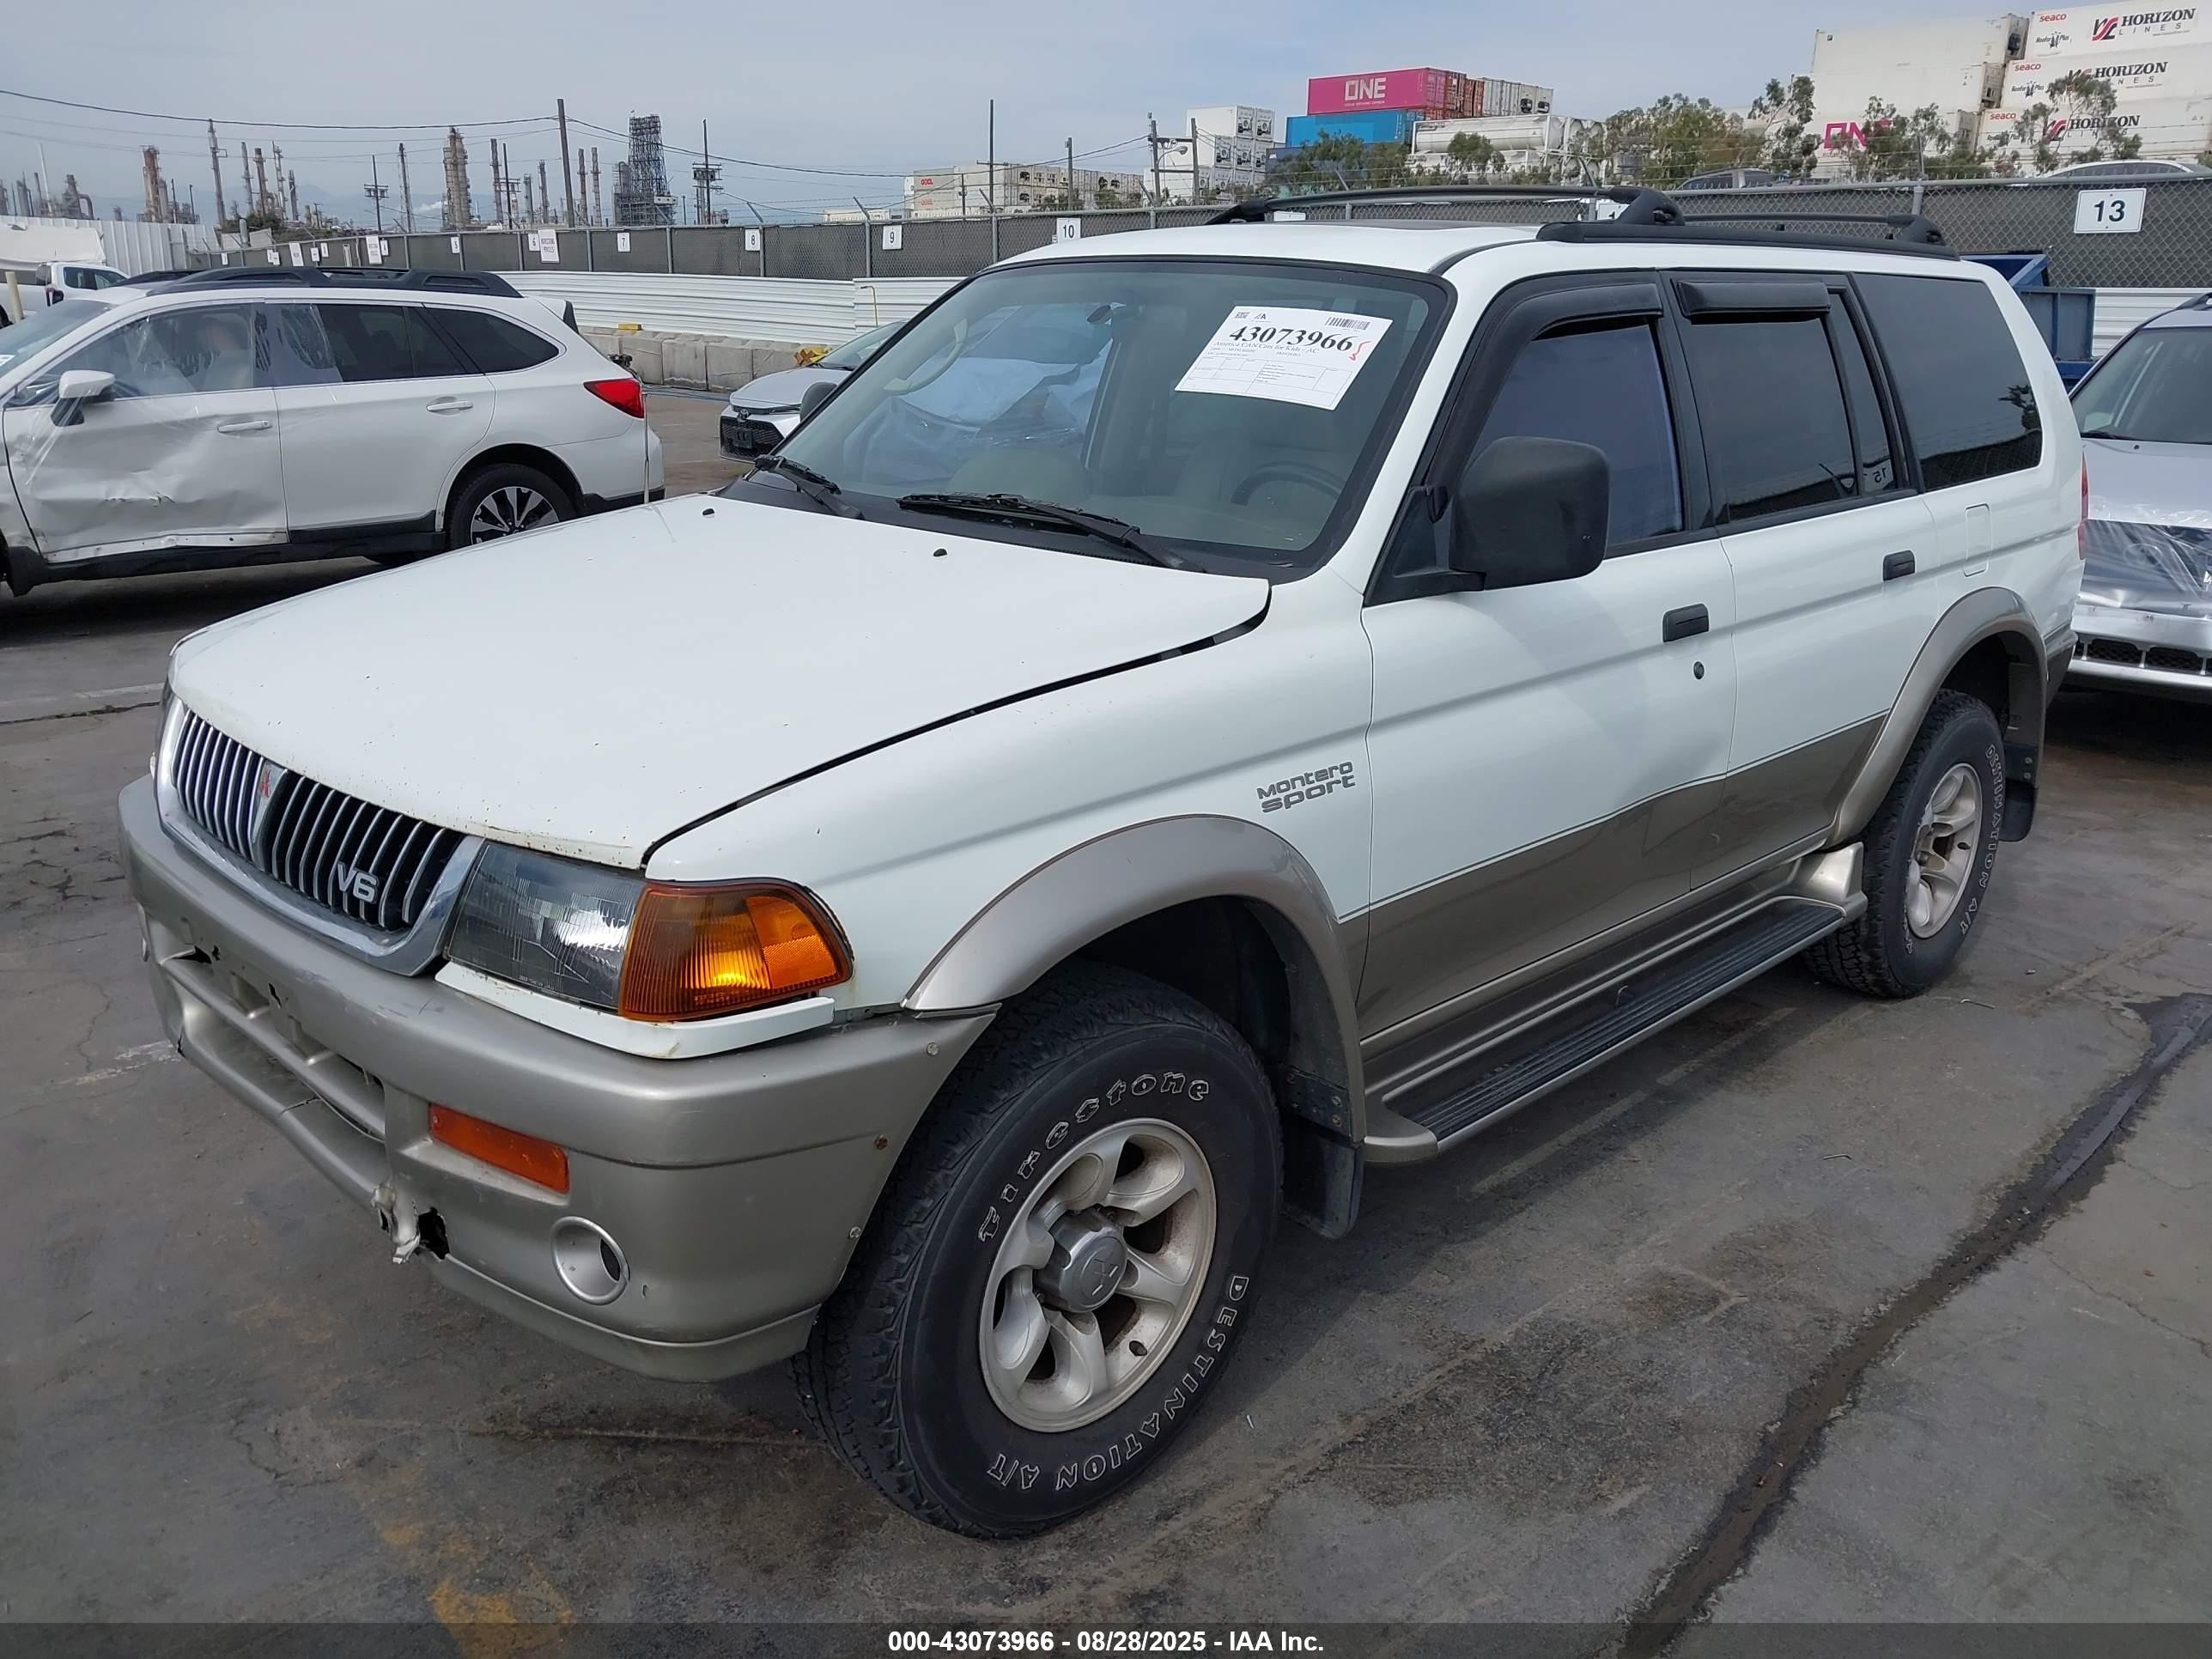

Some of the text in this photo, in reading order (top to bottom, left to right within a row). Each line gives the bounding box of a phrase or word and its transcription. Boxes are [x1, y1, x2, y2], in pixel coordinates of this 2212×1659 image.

[2039, 13, 2067, 22] seaco
[2121, 8, 2197, 27] HORIZON
[2118, 22, 2182, 35] LINES
[2014, 63, 2041, 71] seaco
[2094, 62, 2168, 78] HORIZON
[1344, 76, 1388, 101] ONE
[2094, 200, 2127, 222] 13
[890, 231, 895, 244] 9
[1062, 224, 1074, 238] 10
[621, 237, 626, 247] 7
[750, 234, 756, 246] 8
[1229, 325, 1358, 351] 43073966
[1256, 761, 1353, 799] Montero
[1978, 744, 2004, 889] DESTINATION
[337, 861, 379, 903] V6
[988, 1274, 1250, 1492] DESTINATION A/T
